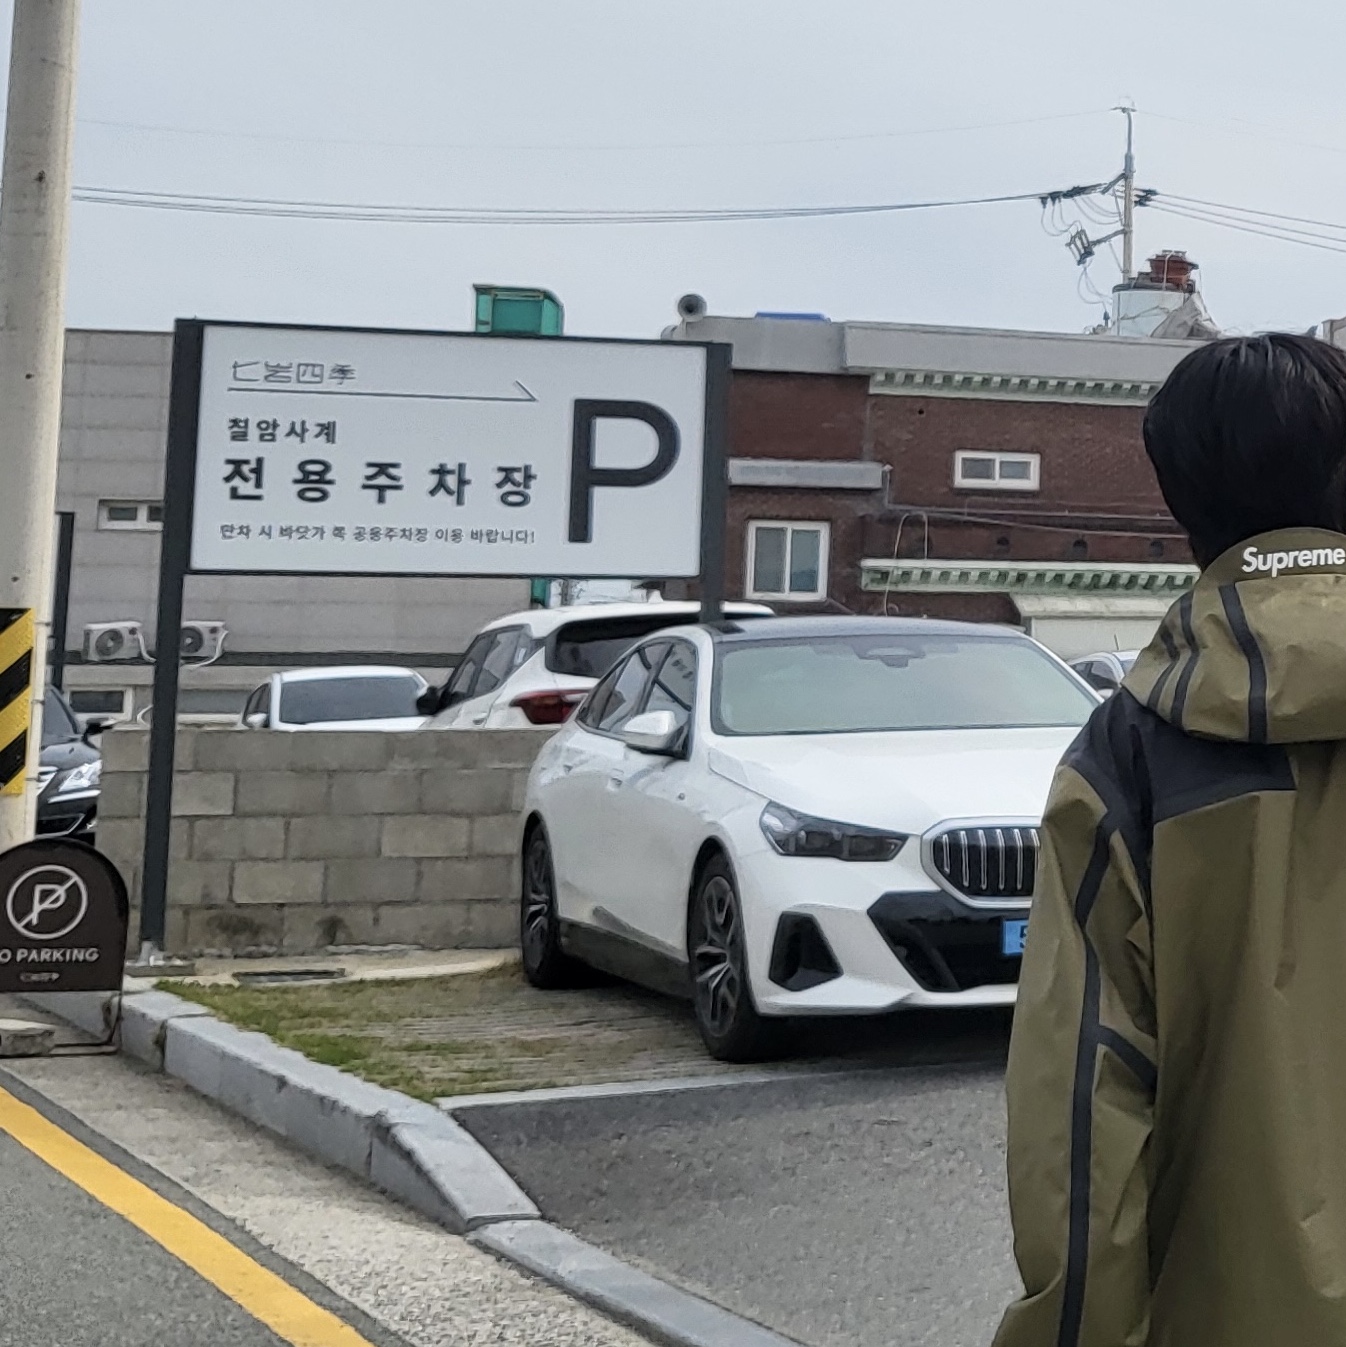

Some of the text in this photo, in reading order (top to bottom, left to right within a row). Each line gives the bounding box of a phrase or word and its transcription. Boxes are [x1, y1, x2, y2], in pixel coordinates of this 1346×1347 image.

[222, 456, 538, 507] 전용주차장
[568, 398, 682, 544] P
[258, 525, 272, 540] 시
[278, 525, 326, 540] 바닷가
[352, 526, 428, 542] 공용주차장
[434, 527, 464, 544] 이용
[470, 528, 535, 544] 바랍니다!
[1241, 547, 1346, 578] Supreme
[16, 947, 100, 963] PARKING
